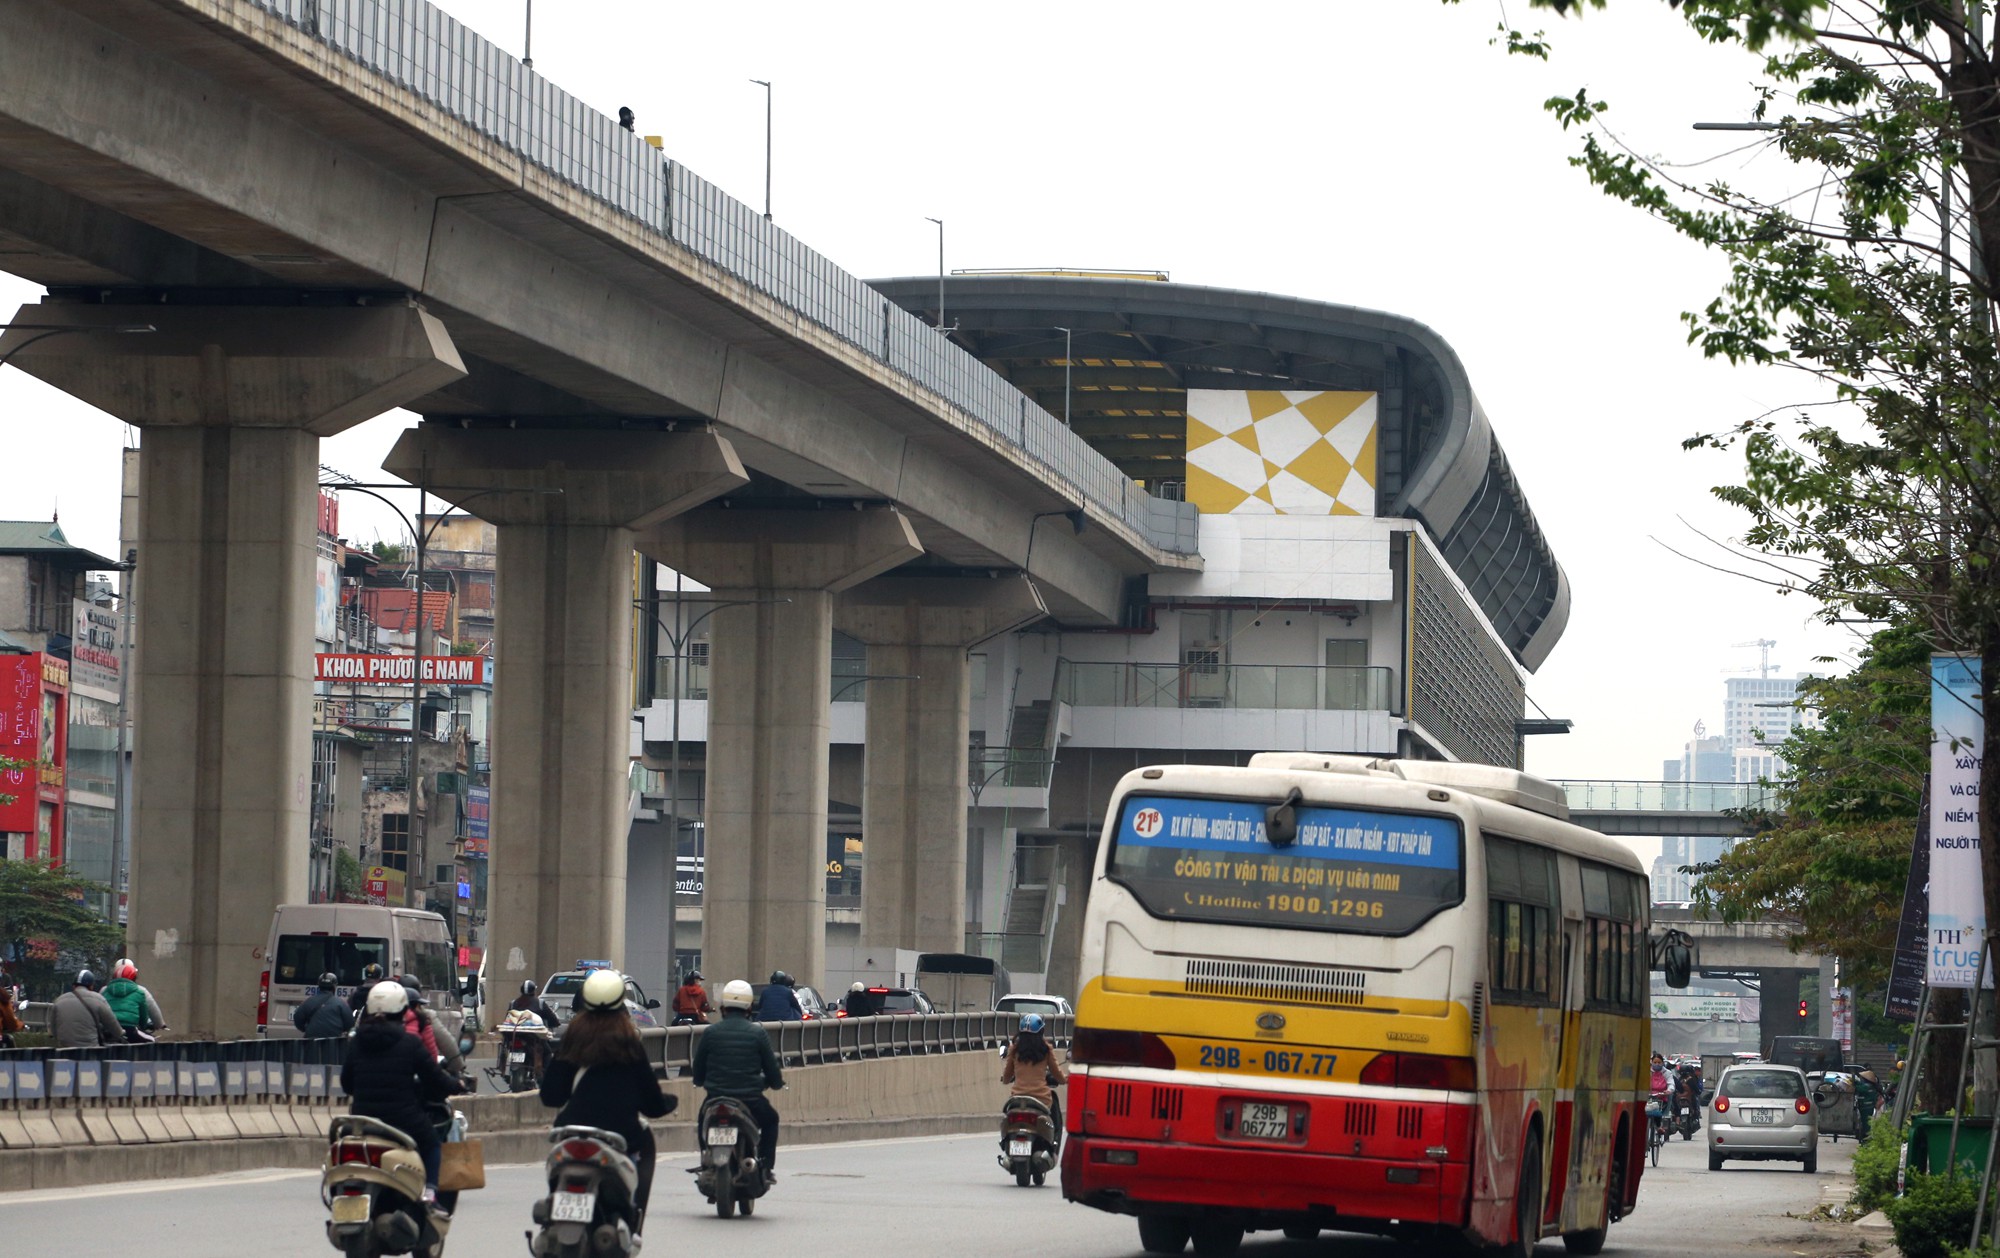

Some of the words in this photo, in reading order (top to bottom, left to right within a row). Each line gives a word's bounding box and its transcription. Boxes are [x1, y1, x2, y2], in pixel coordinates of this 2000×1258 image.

[323, 658, 365, 678] KHOA
[436, 660, 474, 681] NAM
[1955, 756, 1976, 769] XÂY
[1950, 782, 1964, 796] VÀ
[1966, 781, 1980, 796] CỦ
[1136, 811, 1159, 833] 21B
[1171, 816, 1180, 837] BX
[1210, 812, 1236, 841] NGUYỄN
[1255, 822, 1269, 843] CH
[1302, 821, 1317, 846] GIÁP
[1317, 822, 1331, 847] BÁT
[1335, 828, 1345, 848] BX
[1400, 829, 1418, 854] PHÁP
[1936, 835, 1969, 849] NGƯỜI
[1175, 856, 1212, 878] CÔNG
[1214, 861, 1231, 879] TY
[1234, 860, 1258, 886] VẬN
[1282, 866, 1289, 883] &
[1293, 866, 1324, 890] DỊCH
[1327, 869, 1344, 892] VỤ
[675, 878, 704, 891] entho
[1199, 895, 1261, 909] Hotline
[1266, 894, 1383, 918] 1900.1296
[1934, 929, 1961, 944] TH
[1933, 945, 1981, 968] true
[1386, 1032, 1429, 1043] TRANSINCO
[1200, 1045, 1240, 1068] 29B
[1264, 1050, 1337, 1076] 067.77
[1252, 1105, 1277, 1120] 29B
[1242, 1121, 1286, 1137] 067.77
